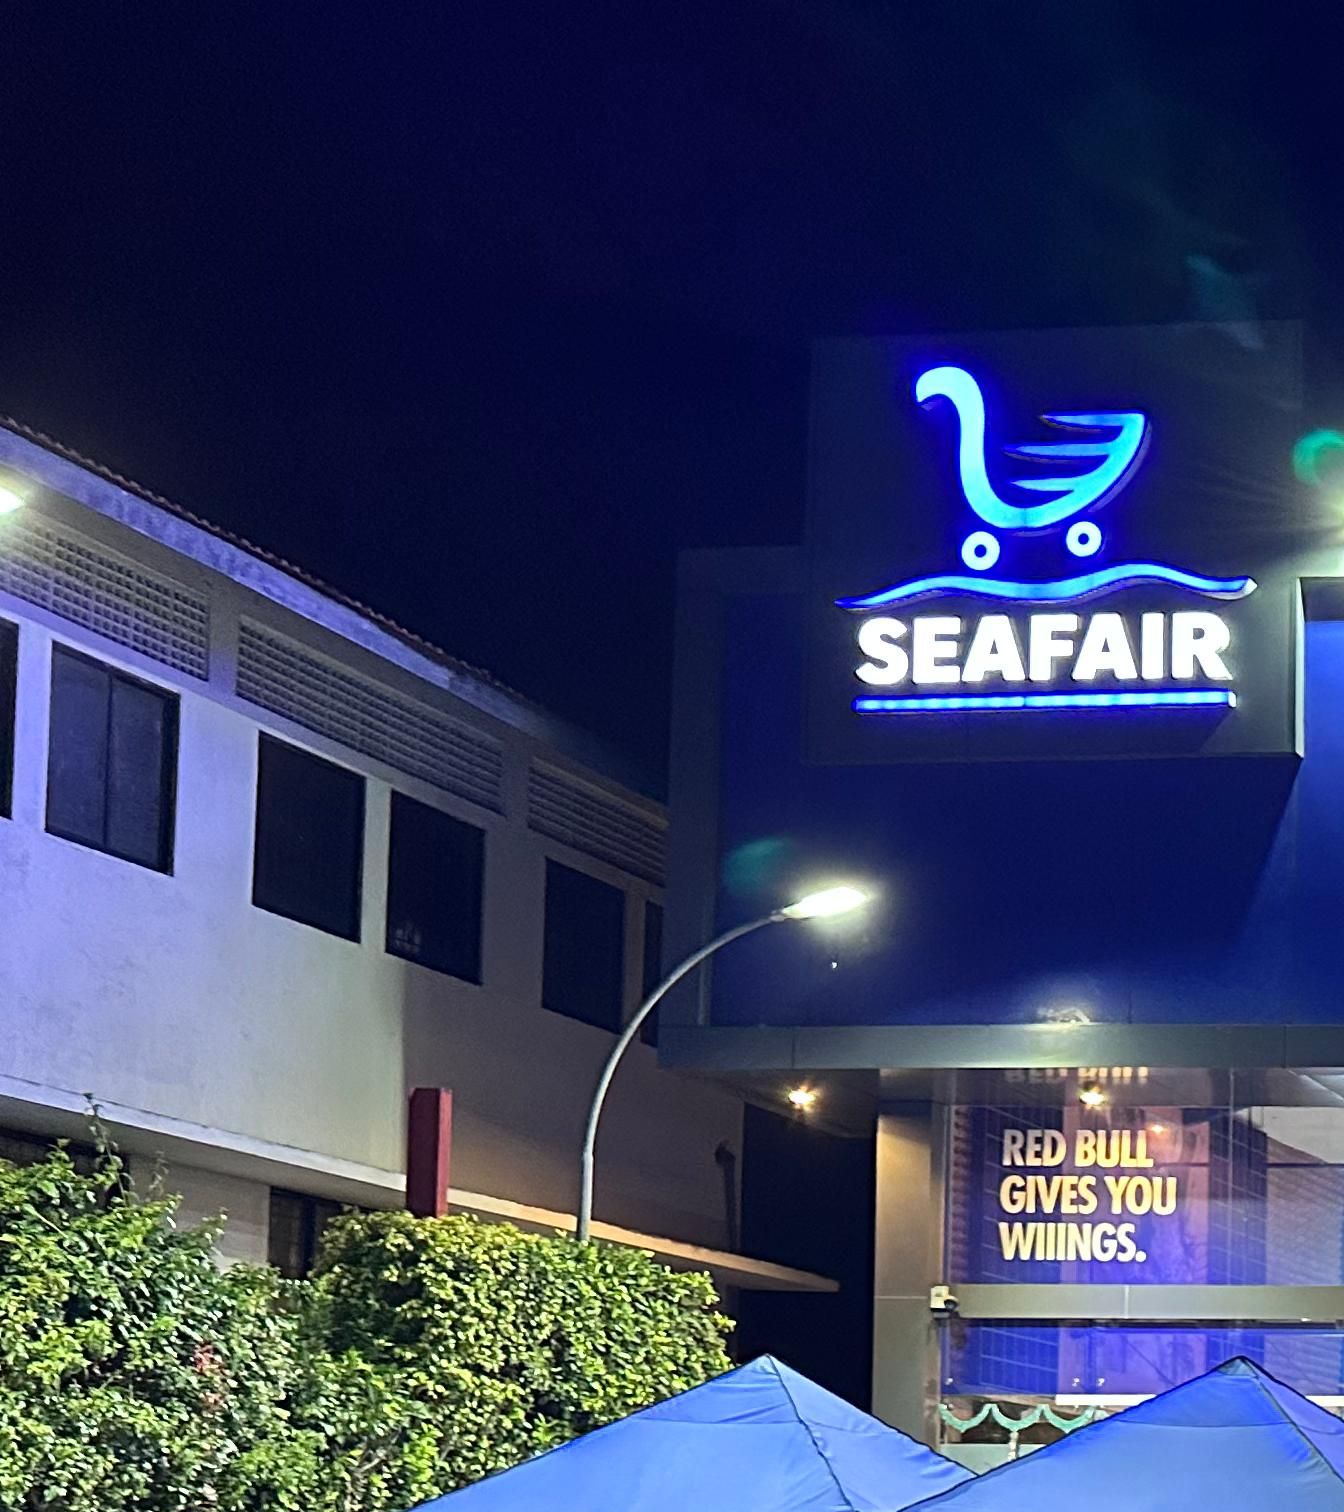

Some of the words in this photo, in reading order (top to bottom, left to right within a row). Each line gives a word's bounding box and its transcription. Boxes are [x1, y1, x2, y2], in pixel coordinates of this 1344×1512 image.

[855, 611, 1232, 686] SEAFAIR
[1002, 1129, 1067, 1167] RED
[1074, 1129, 1154, 1168] BULL
[1000, 1175, 1098, 1214] GIVES
[1104, 1176, 1178, 1216] YOU
[998, 1222, 1148, 1263] WIIINGS.
